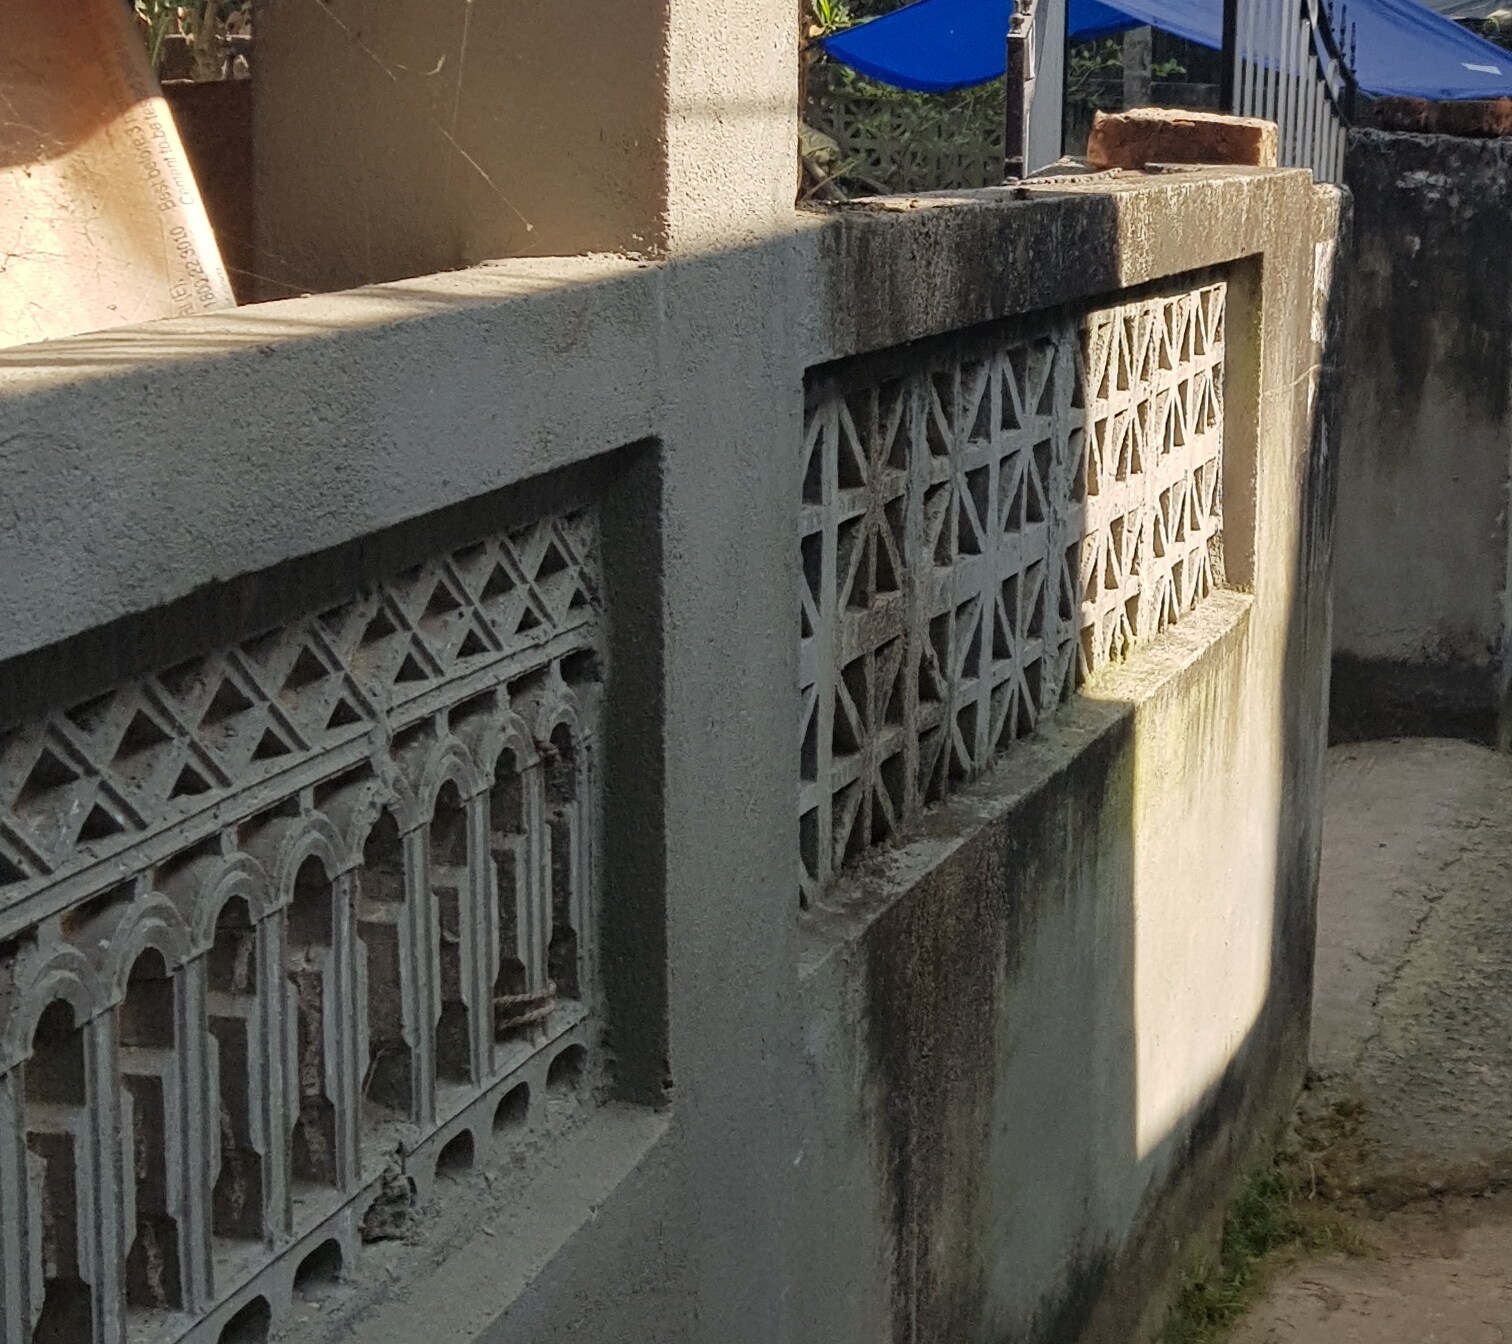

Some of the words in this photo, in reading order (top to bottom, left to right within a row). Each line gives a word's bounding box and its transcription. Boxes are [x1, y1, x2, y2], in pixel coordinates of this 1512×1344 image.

[124, 125, 143, 137] 3
[149, 121, 166, 140] be
[132, 137, 160, 181] before
[158, 141, 173, 155] to
[151, 180, 176, 212] Best
[163, 156, 194, 206] Cement
[169, 225, 196, 259] 3010
[185, 259, 204, 278] 22
[193, 277, 217, 309] 1800
